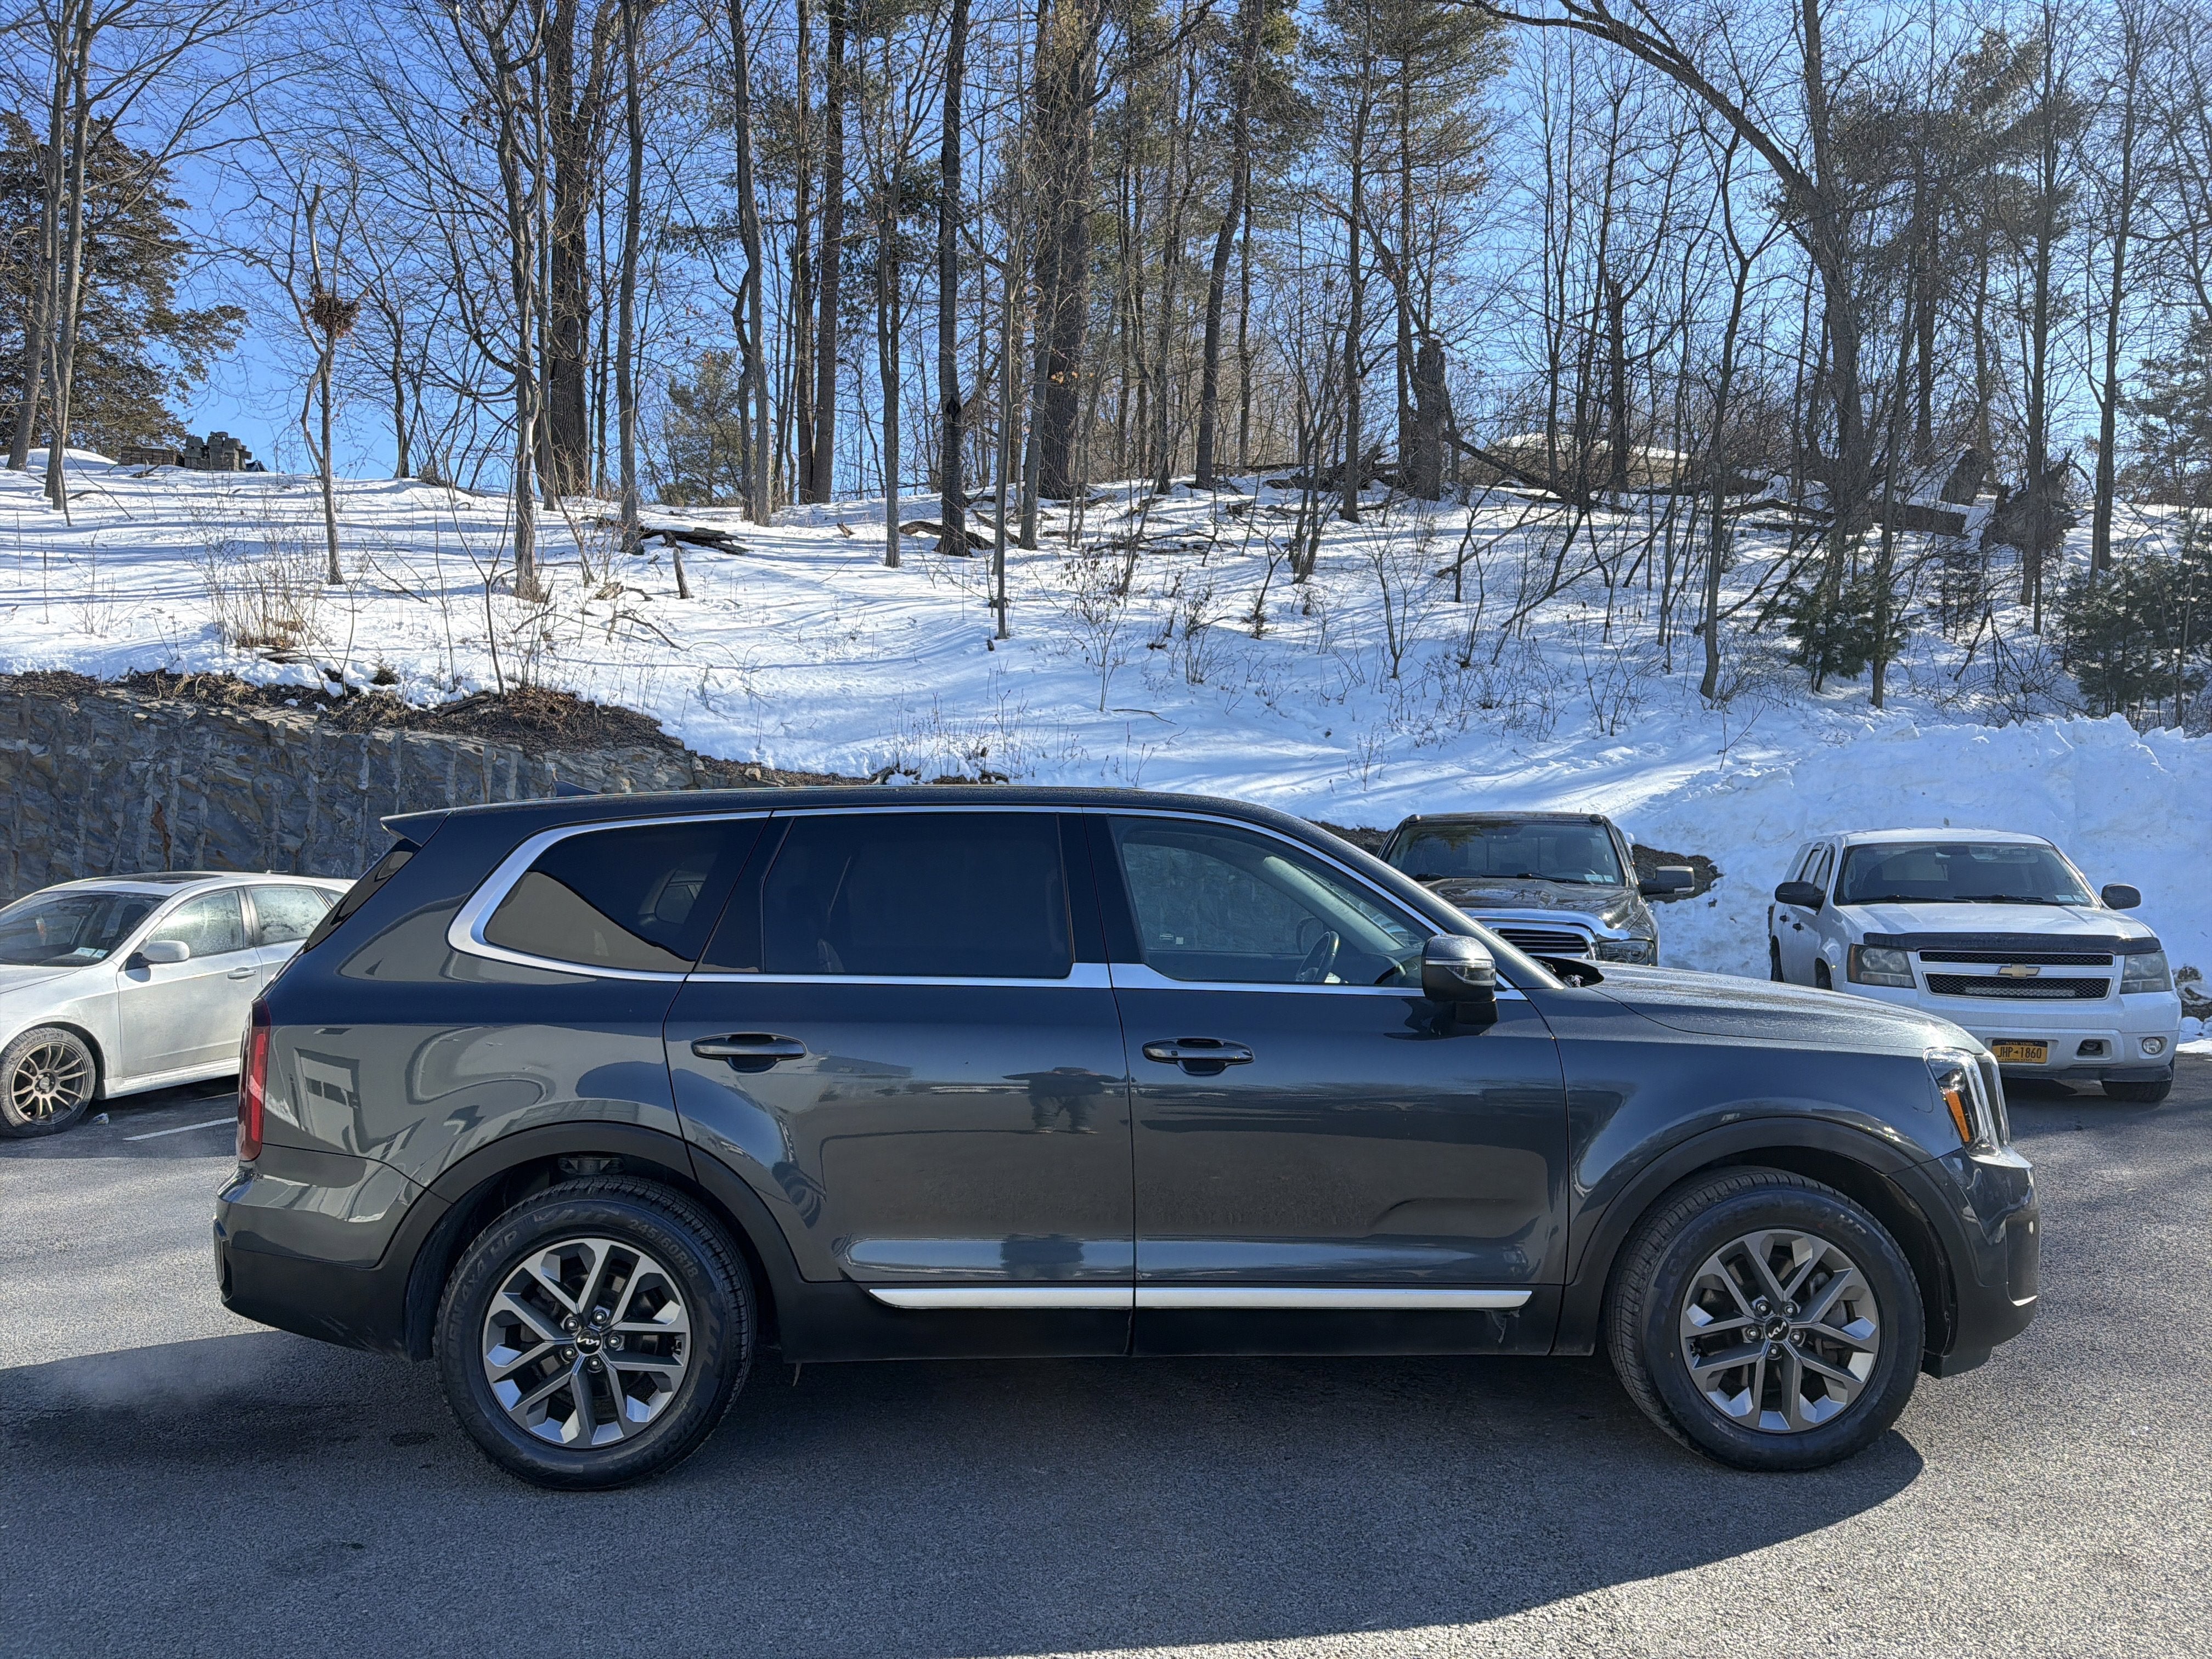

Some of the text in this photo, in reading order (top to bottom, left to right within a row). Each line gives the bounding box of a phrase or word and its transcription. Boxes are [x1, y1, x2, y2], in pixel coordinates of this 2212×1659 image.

[1997, 1047, 2042, 1059] JHP 1860
[628, 1219, 698, 1278] 245/60R18
[1768, 1321, 1787, 1338] KIA
[577, 1337, 600, 1346] KIA
